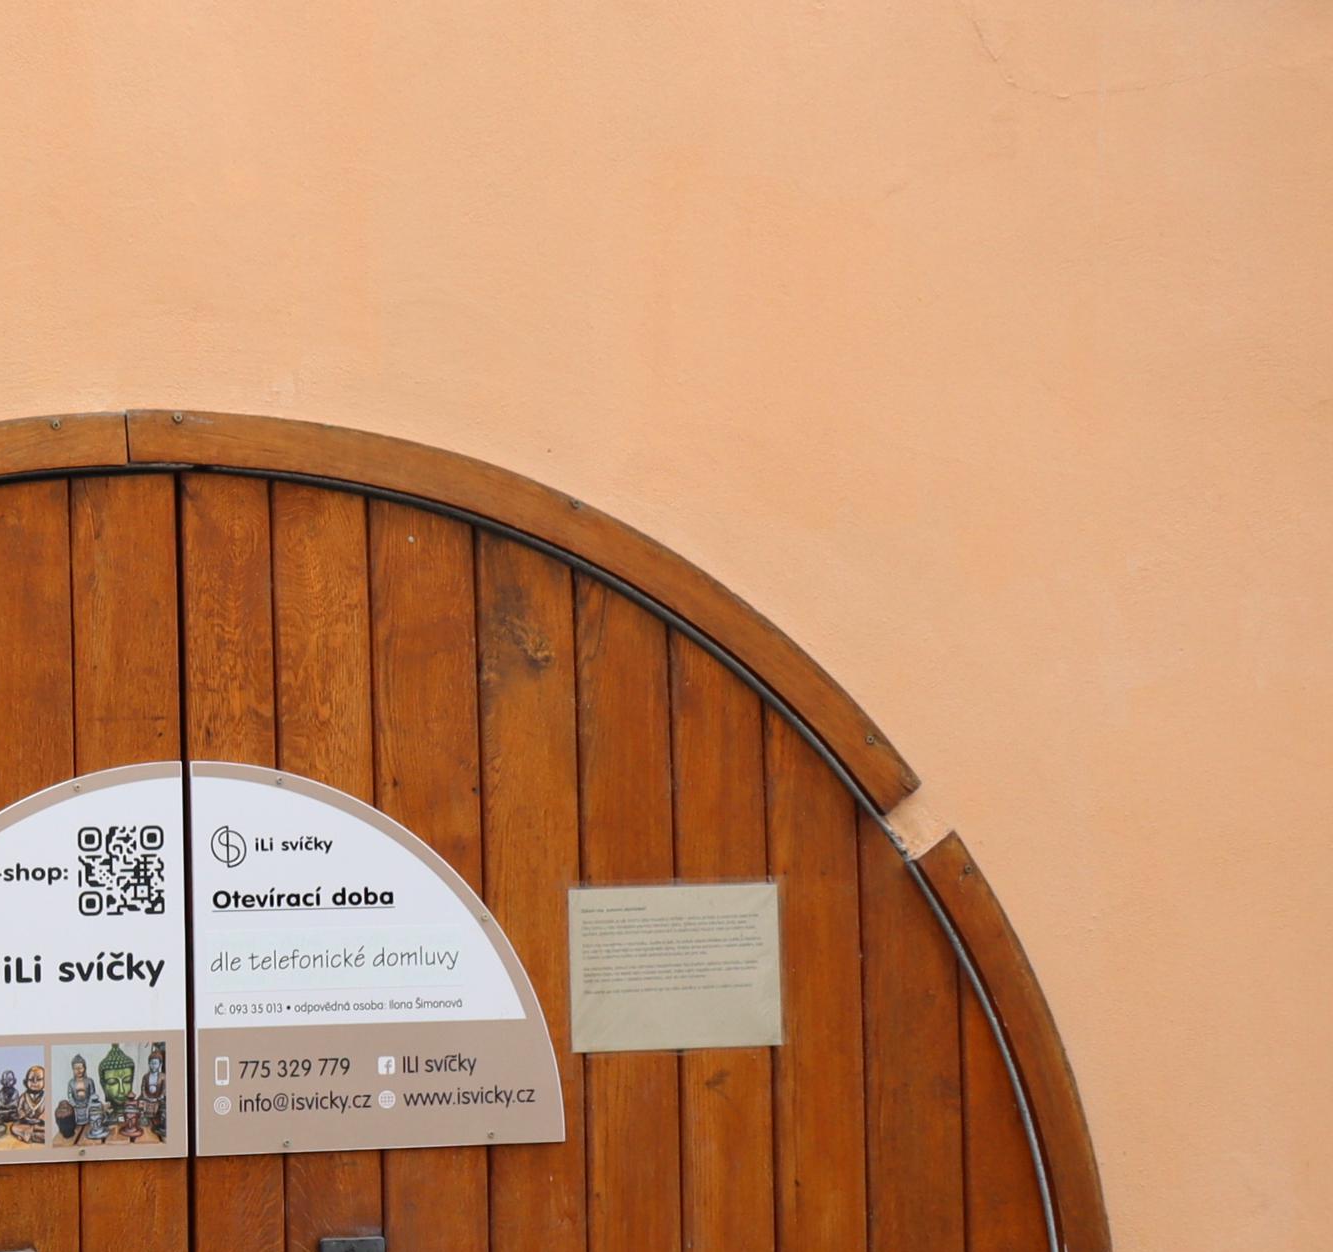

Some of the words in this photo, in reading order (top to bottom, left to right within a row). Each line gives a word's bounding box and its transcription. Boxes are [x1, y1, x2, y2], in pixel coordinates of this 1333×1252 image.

[255, 837, 274, 852] iLi
[281, 836, 333, 854] svíčky
[212, 886, 321, 909] Otevírací
[332, 886, 395, 906] doba
[4, 955, 41, 984] iLi
[58, 951, 165, 987] svíčky
[211, 952, 241, 972] dle
[248, 945, 365, 971] telefonické
[372, 946, 459, 970] domluvy
[229, 1004, 249, 1014] 093
[251, 1003, 264, 1014] 35
[266, 1002, 283, 1014] 013
[294, 1000, 350, 1014] odpovědná
[388, 1000, 413, 1010] Ilona
[415, 997, 463, 1010] Šimonová
[239, 1060, 271, 1079] 775
[277, 1059, 311, 1078] 329
[318, 1057, 351, 1077] 779
[424, 1053, 477, 1076] svíčky
[238, 1091, 372, 1113] info@isvicky.cz
[403, 1086, 536, 1107] www.isvicky.cz
